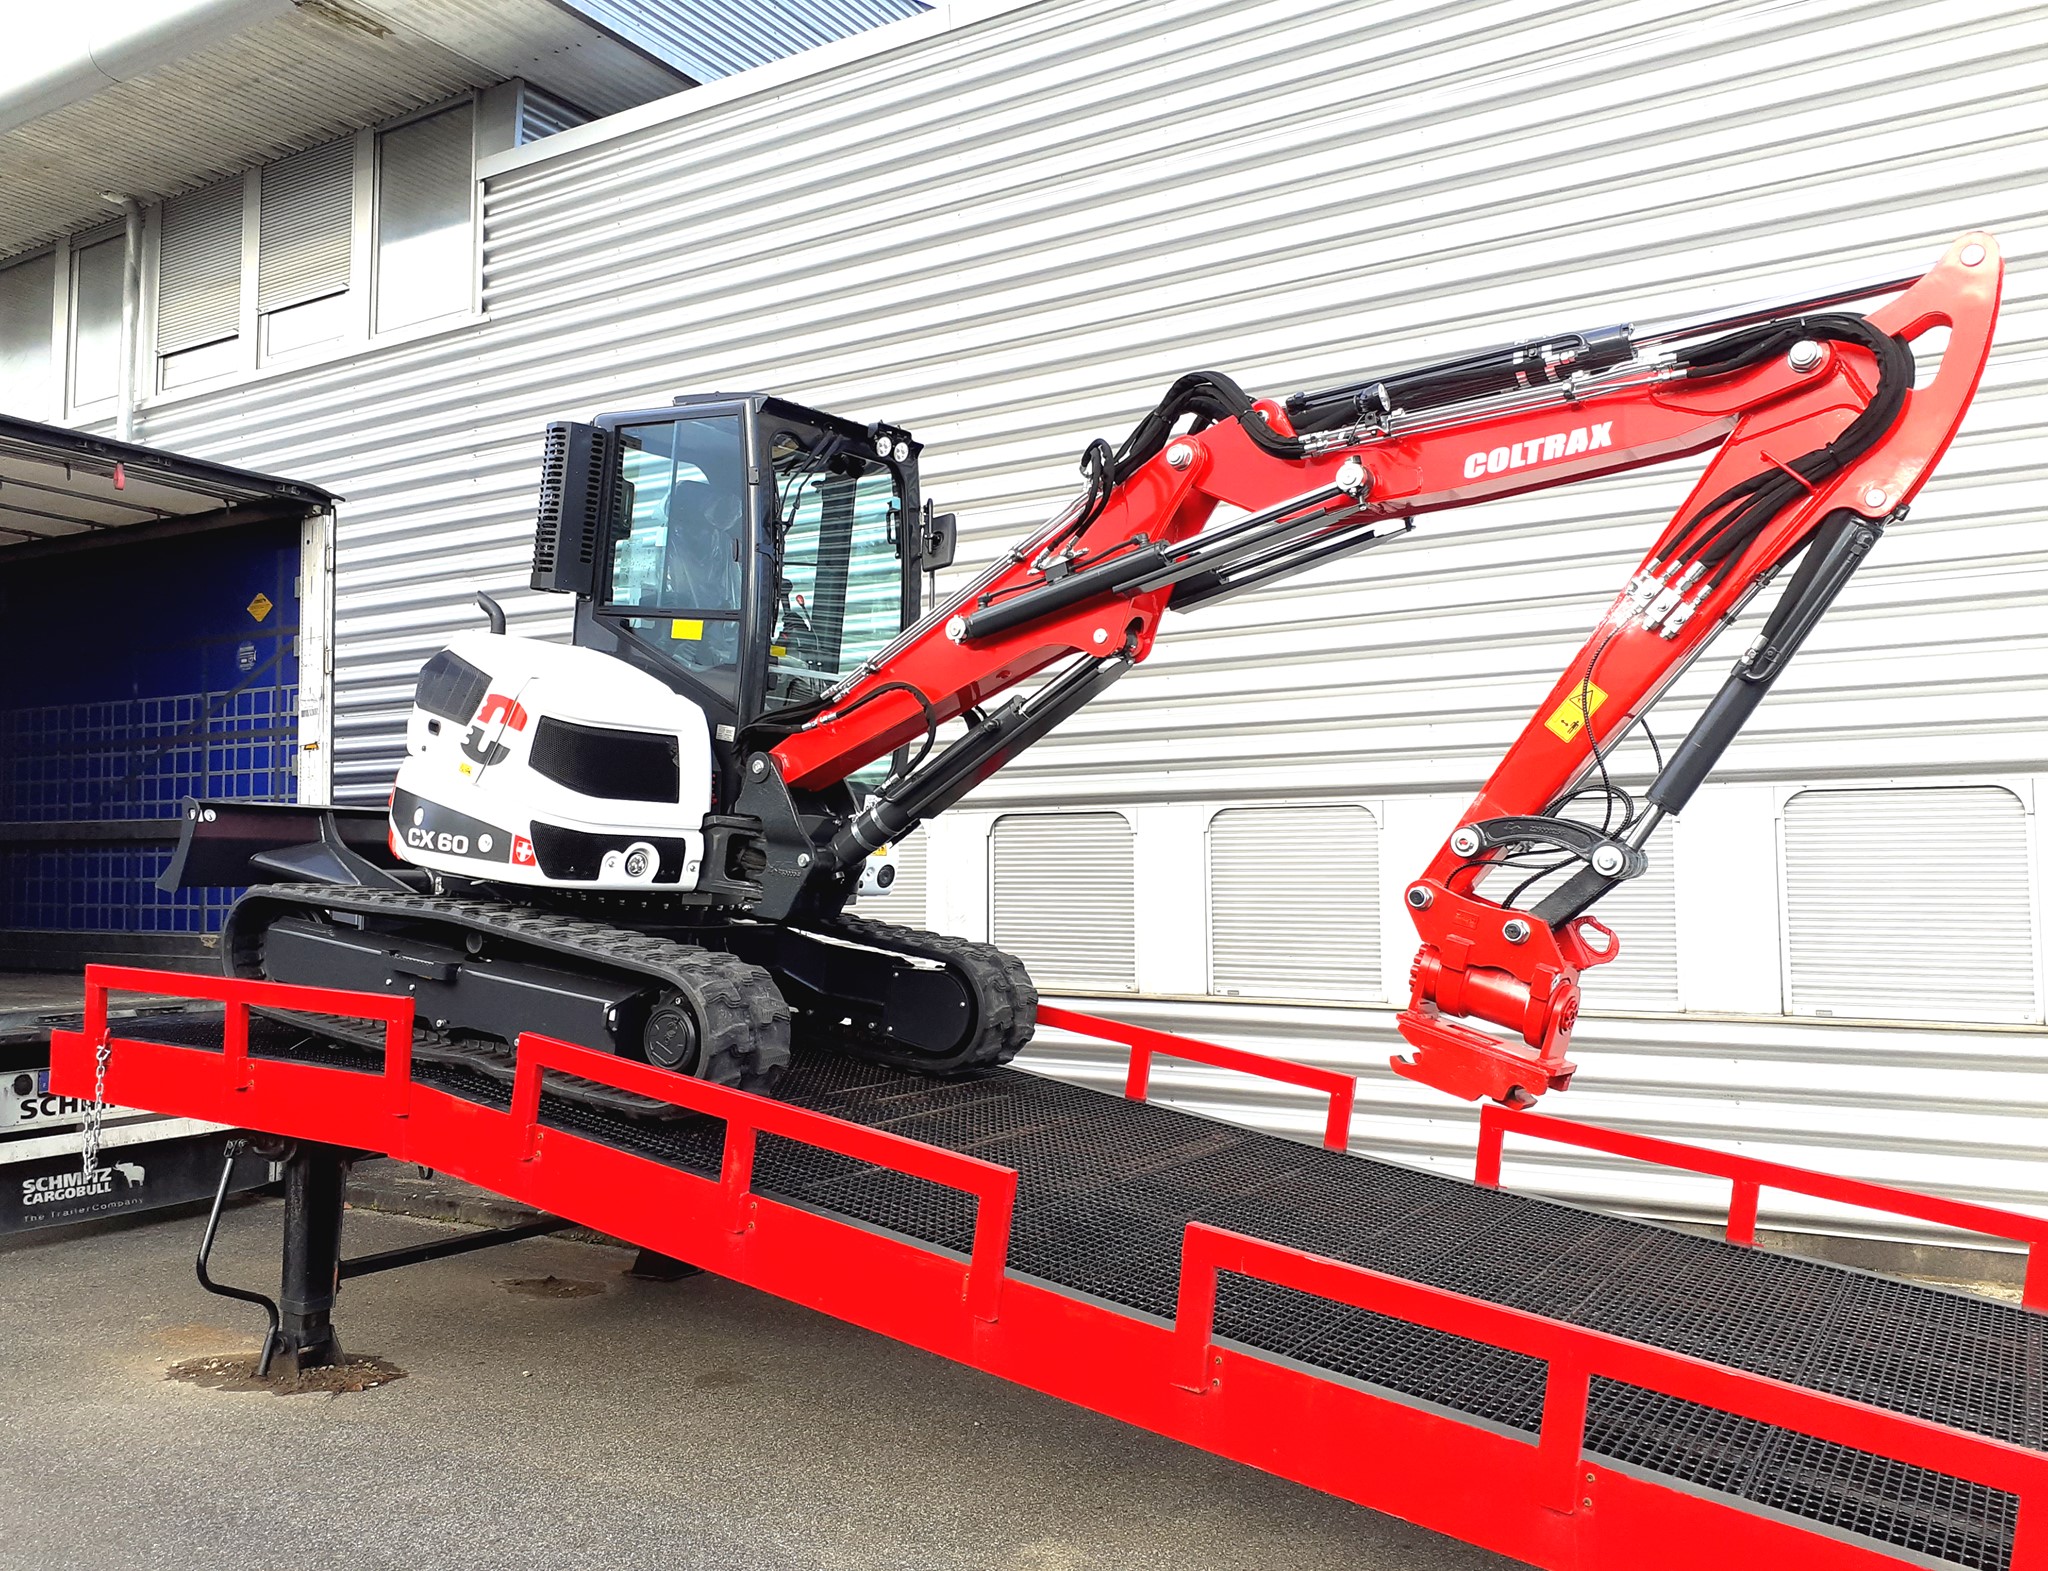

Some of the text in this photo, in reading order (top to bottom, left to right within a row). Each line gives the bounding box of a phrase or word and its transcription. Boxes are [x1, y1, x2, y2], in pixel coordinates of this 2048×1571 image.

[1463, 421, 1613, 479] COLTRAX
[407, 827, 469, 854] CX 60
[22, 1182, 112, 1206] CARGOBULL
[24, 1214, 45, 1222] The
